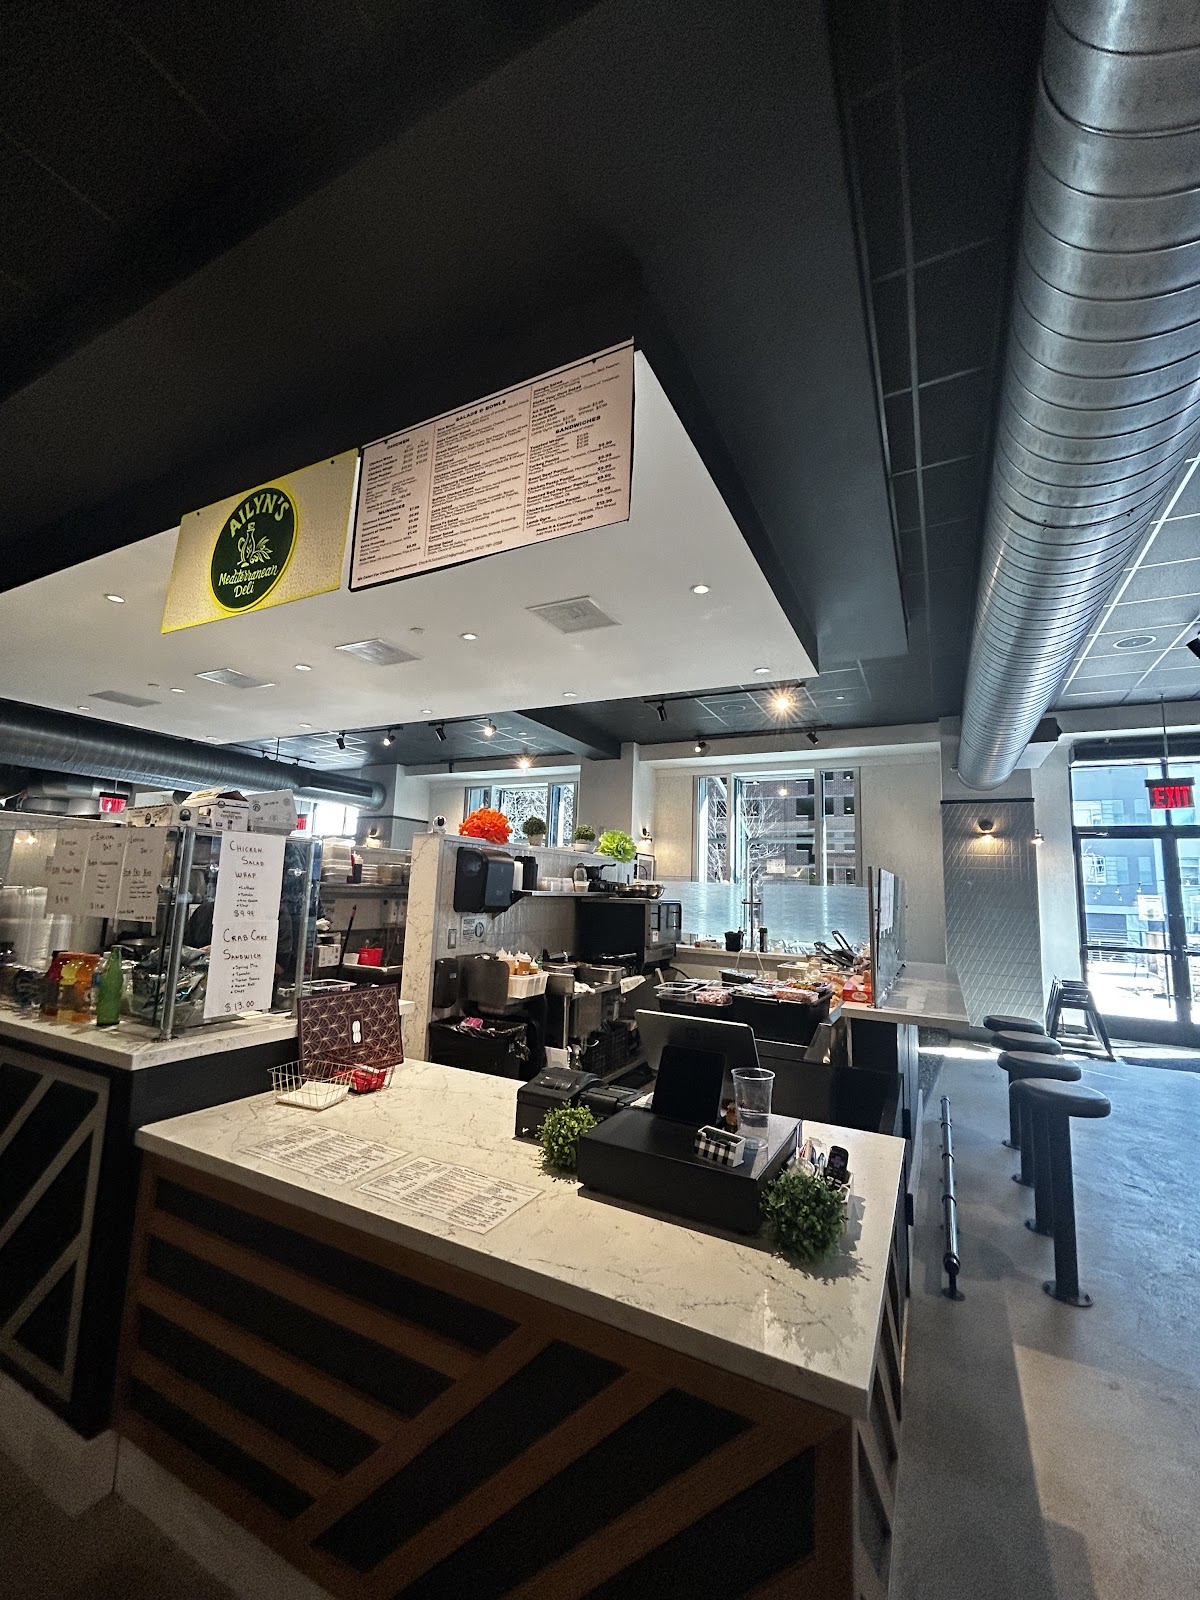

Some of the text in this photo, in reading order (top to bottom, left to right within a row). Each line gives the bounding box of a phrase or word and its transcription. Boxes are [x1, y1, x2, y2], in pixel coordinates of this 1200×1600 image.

[455, 410, 477, 421] SALADS
[485, 400, 506, 410] BOWLS
[555, 416, 600, 433] SANDWICHES
[230, 493, 290, 538] AILYN'S
[218, 565, 279, 586] Mediterranean
[233, 581, 255, 598] Deli
[1153, 785, 1190, 808] EXIT
[229, 840, 263, 853] CHICKEN
[241, 855, 265, 867] SALAD
[235, 870, 257, 879] WRAP
[223, 928, 268, 943] CRAB CAKE
[223, 949, 262, 960] SANDWICH
